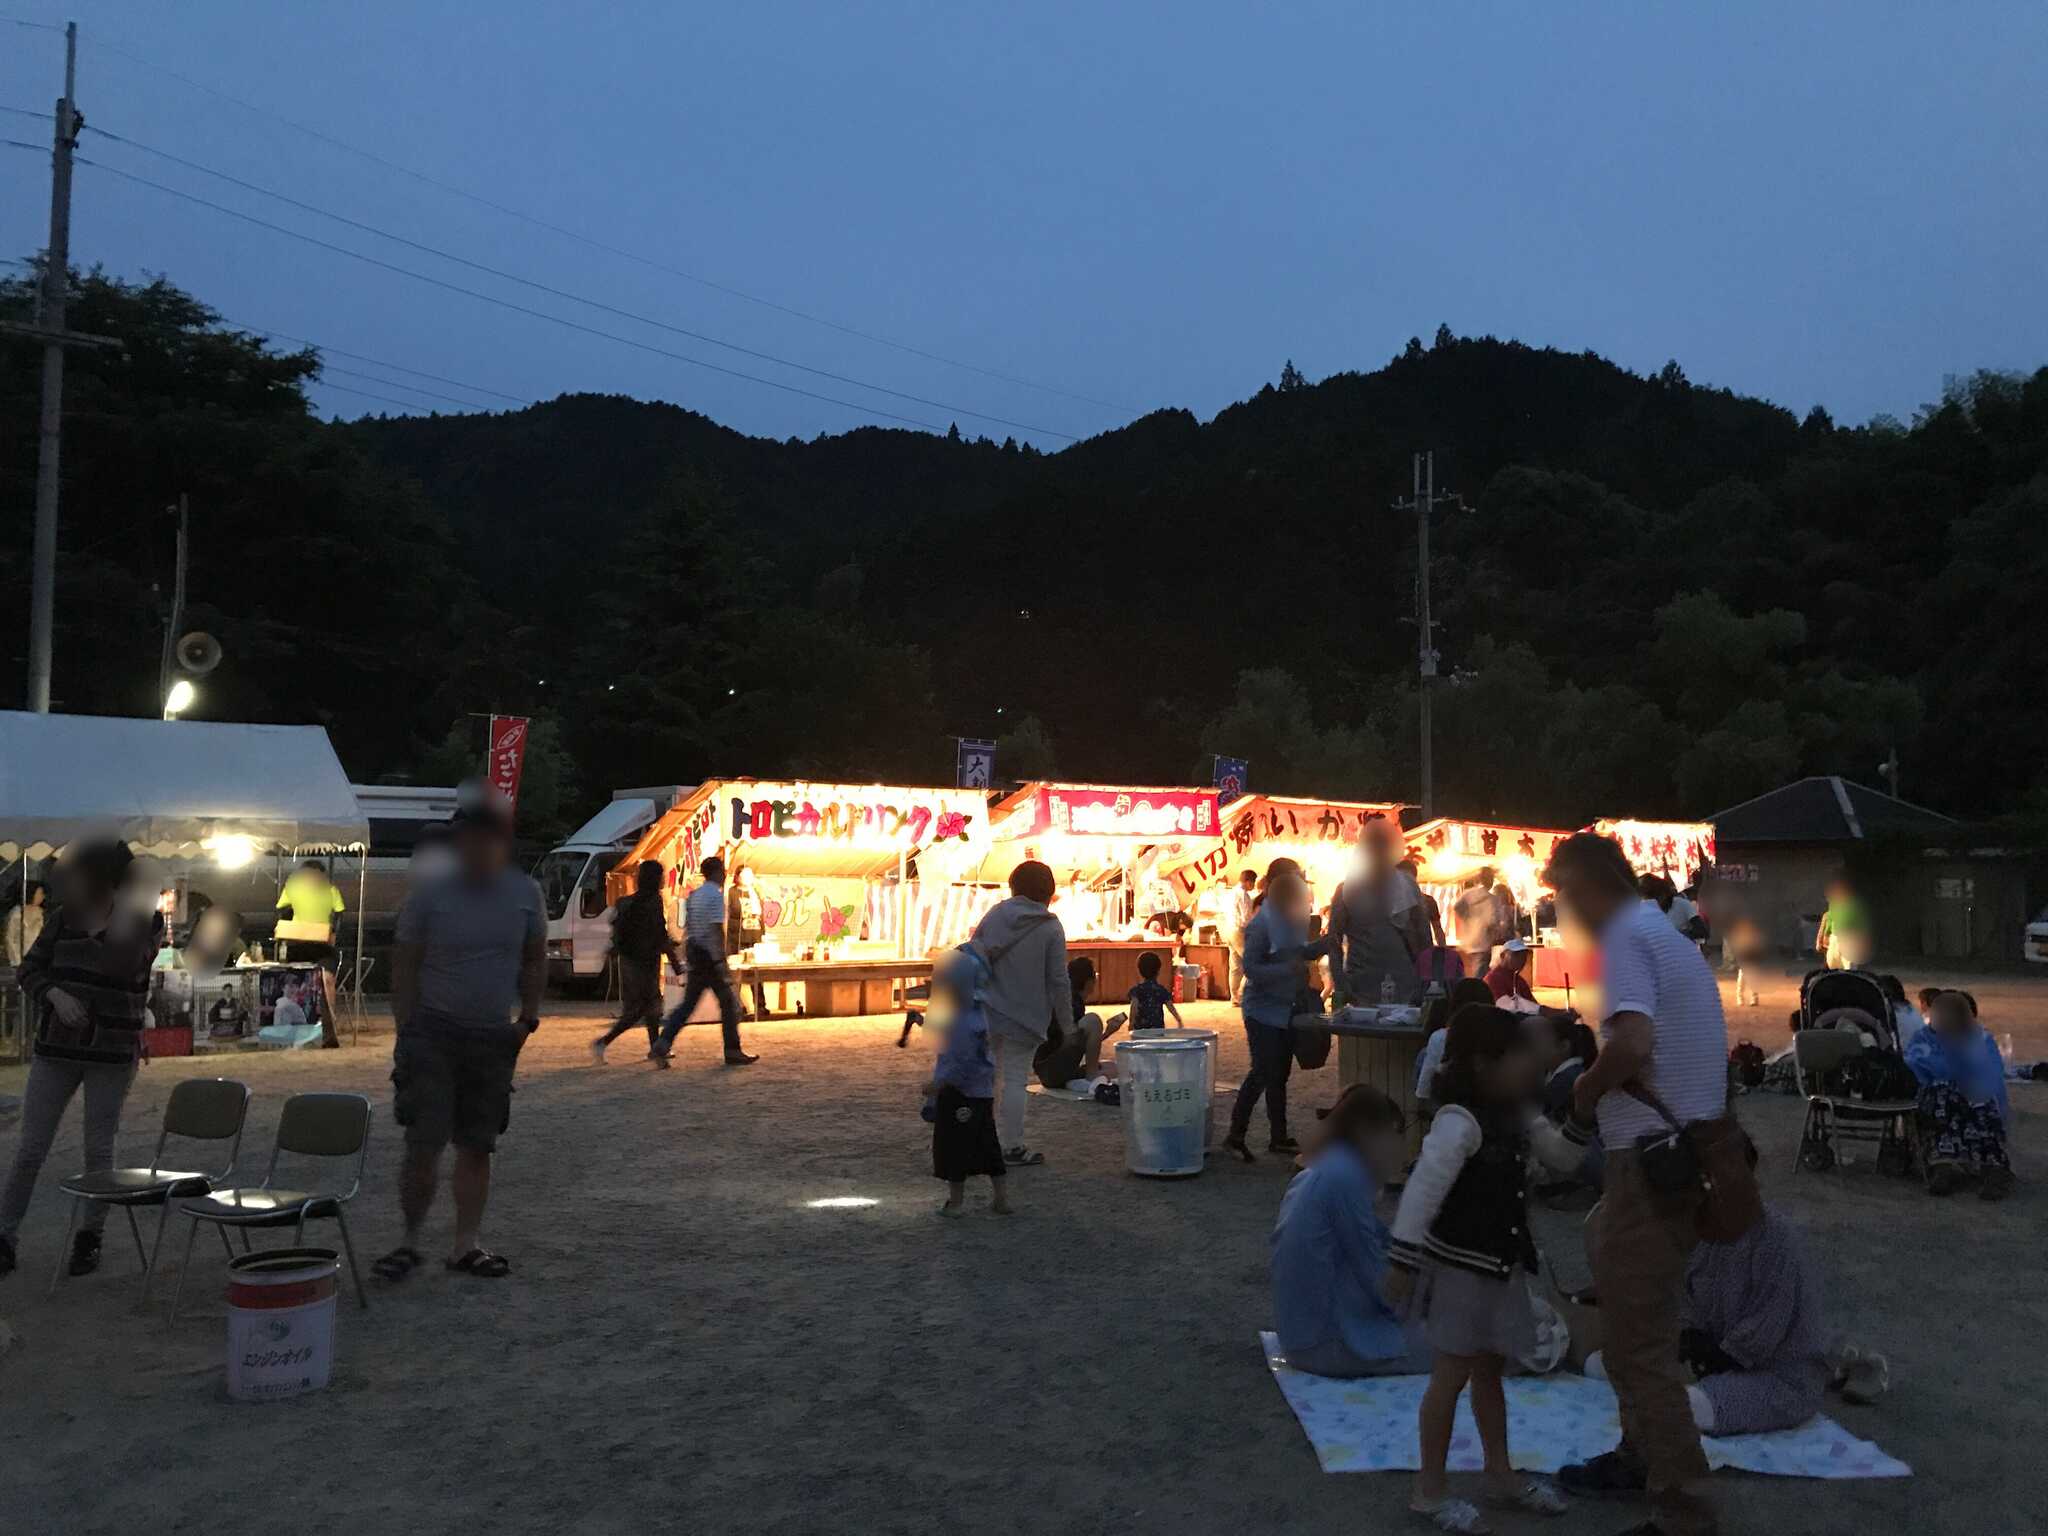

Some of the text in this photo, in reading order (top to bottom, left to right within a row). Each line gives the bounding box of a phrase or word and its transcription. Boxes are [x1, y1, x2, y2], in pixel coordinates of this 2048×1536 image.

[731, 797, 932, 843] トロピカルドリンク
